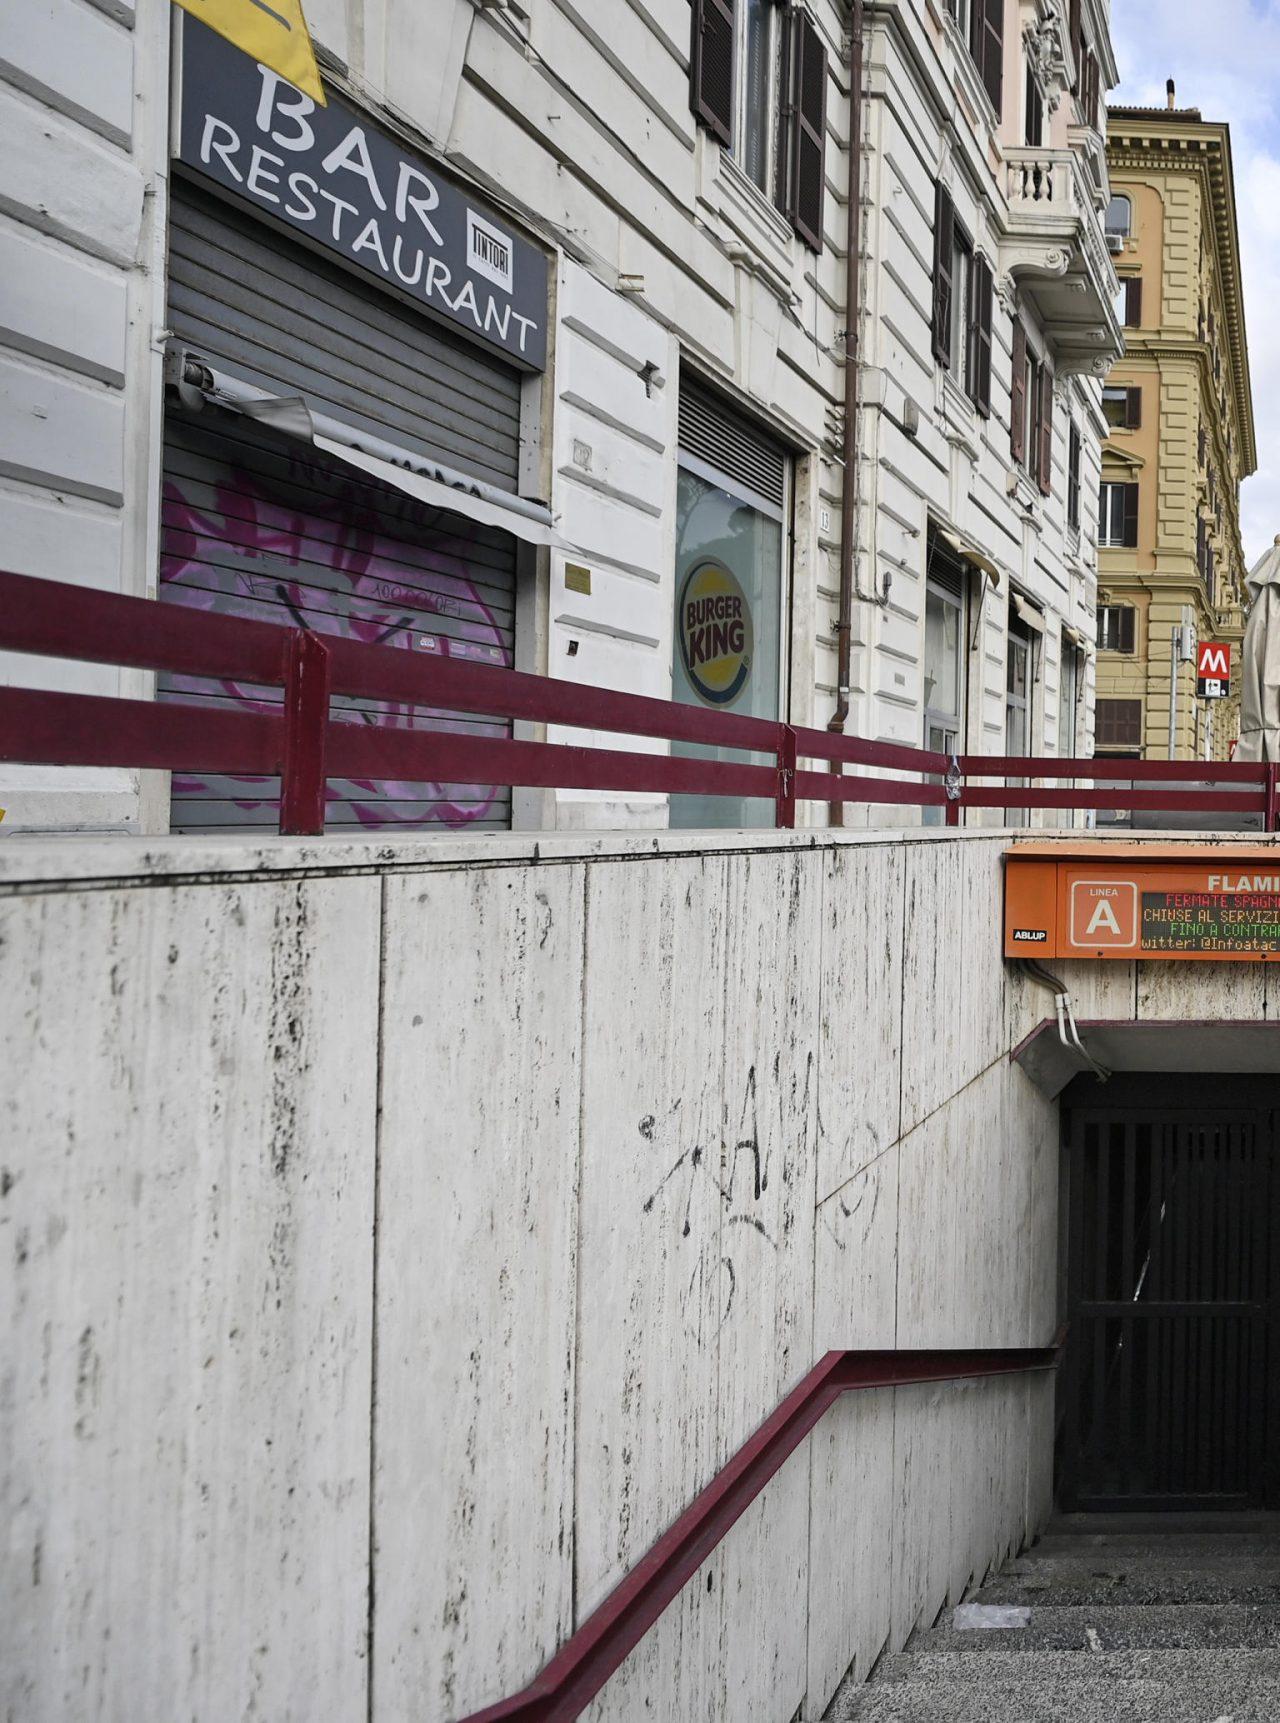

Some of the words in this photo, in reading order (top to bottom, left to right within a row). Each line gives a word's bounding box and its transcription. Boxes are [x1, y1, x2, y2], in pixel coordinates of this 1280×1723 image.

[256, 63, 444, 247] BAR
[200, 114, 538, 351] RESTAURANT
[472, 223, 508, 275] TINTORI
[821, 511, 829, 529] 13
[686, 595, 742, 631] BURGER
[689, 620, 745, 669] KING
[1199, 648, 1228, 673] M
[1089, 888, 1118, 897] LINEA
[1166, 894, 1228, 908] FERMATE
[1085, 899, 1121, 935] A
[1143, 908, 1193, 922] CHIUSE
[1198, 910, 1214, 923] AL
[1014, 930, 1046, 941] ABLUP
[1170, 922, 1204, 936] FINO
[1210, 924, 1218, 936] A
[1201, 936, 1277, 951] @Infoatac
